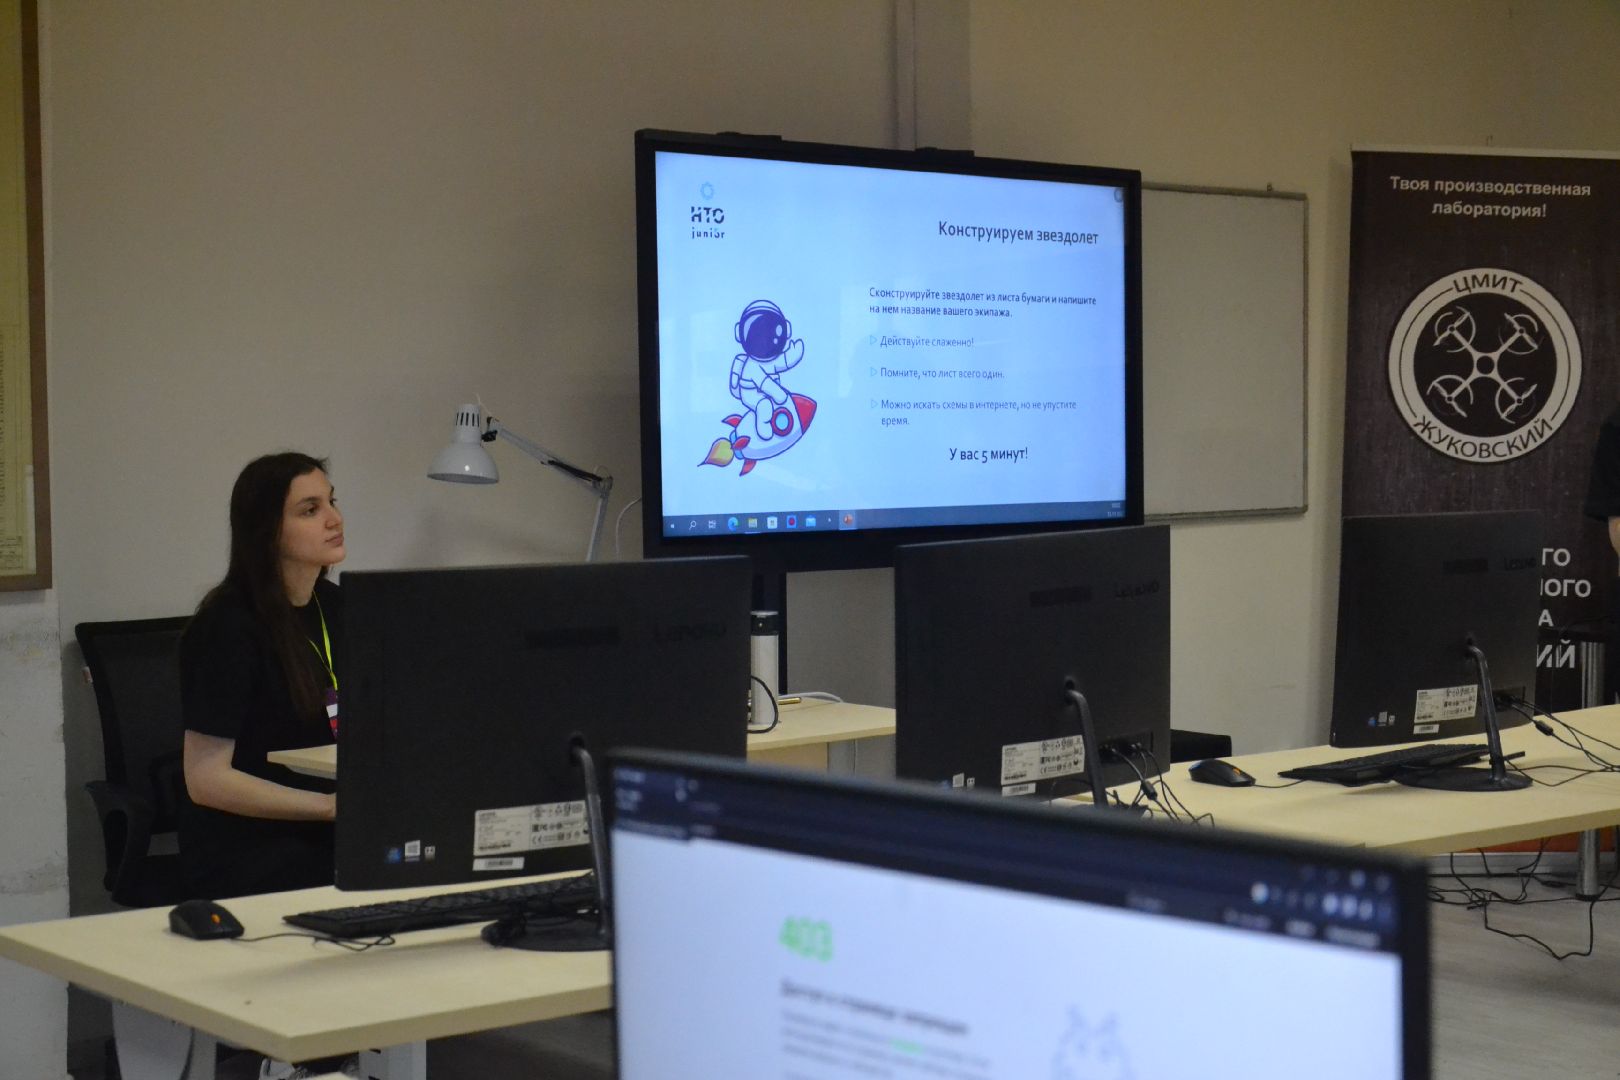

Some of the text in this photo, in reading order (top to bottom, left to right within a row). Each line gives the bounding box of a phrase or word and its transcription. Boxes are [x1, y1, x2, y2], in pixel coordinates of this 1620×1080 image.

[1390, 176, 1591, 196] Твоя производственная
[1432, 201, 1547, 218] лаборатория!
[692, 226, 725, 239] junior
[938, 220, 1099, 246] Конструируем звездолет
[1452, 273, 1524, 294] ЦМИТ
[869, 287, 940, 301] Сконструируйте
[942, 291, 984, 302] звездолет
[986, 293, 996, 301] из
[998, 293, 1020, 302] листа
[1021, 292, 1050, 305] бумаги
[1058, 296, 1097, 305] напишите
[869, 305, 1013, 318] на нем название вашего экипажа.
[880, 335, 974, 348] Действуйте слаженно!
[880, 367, 1005, 380] Помните, что лист всего один.
[881, 399, 911, 409] Можно
[913, 401, 941, 410] искать
[942, 401, 967, 410] схемы
[975, 401, 1019, 412] интернете,
[1021, 401, 1031, 409] но
[1032, 401, 1041, 409] не
[1043, 401, 1077, 412] упустите
[881, 417, 910, 427] время.
[1412, 414, 1554, 459] ЖУКОВСКИЙ
[949, 446, 1028, 464] У вас 5 минут!
[1541, 547, 1571, 567] ГО
[1540, 578, 1591, 598] ОГО
[1538, 608, 1554, 627] А
[1536, 638, 1576, 669] ИЙ
